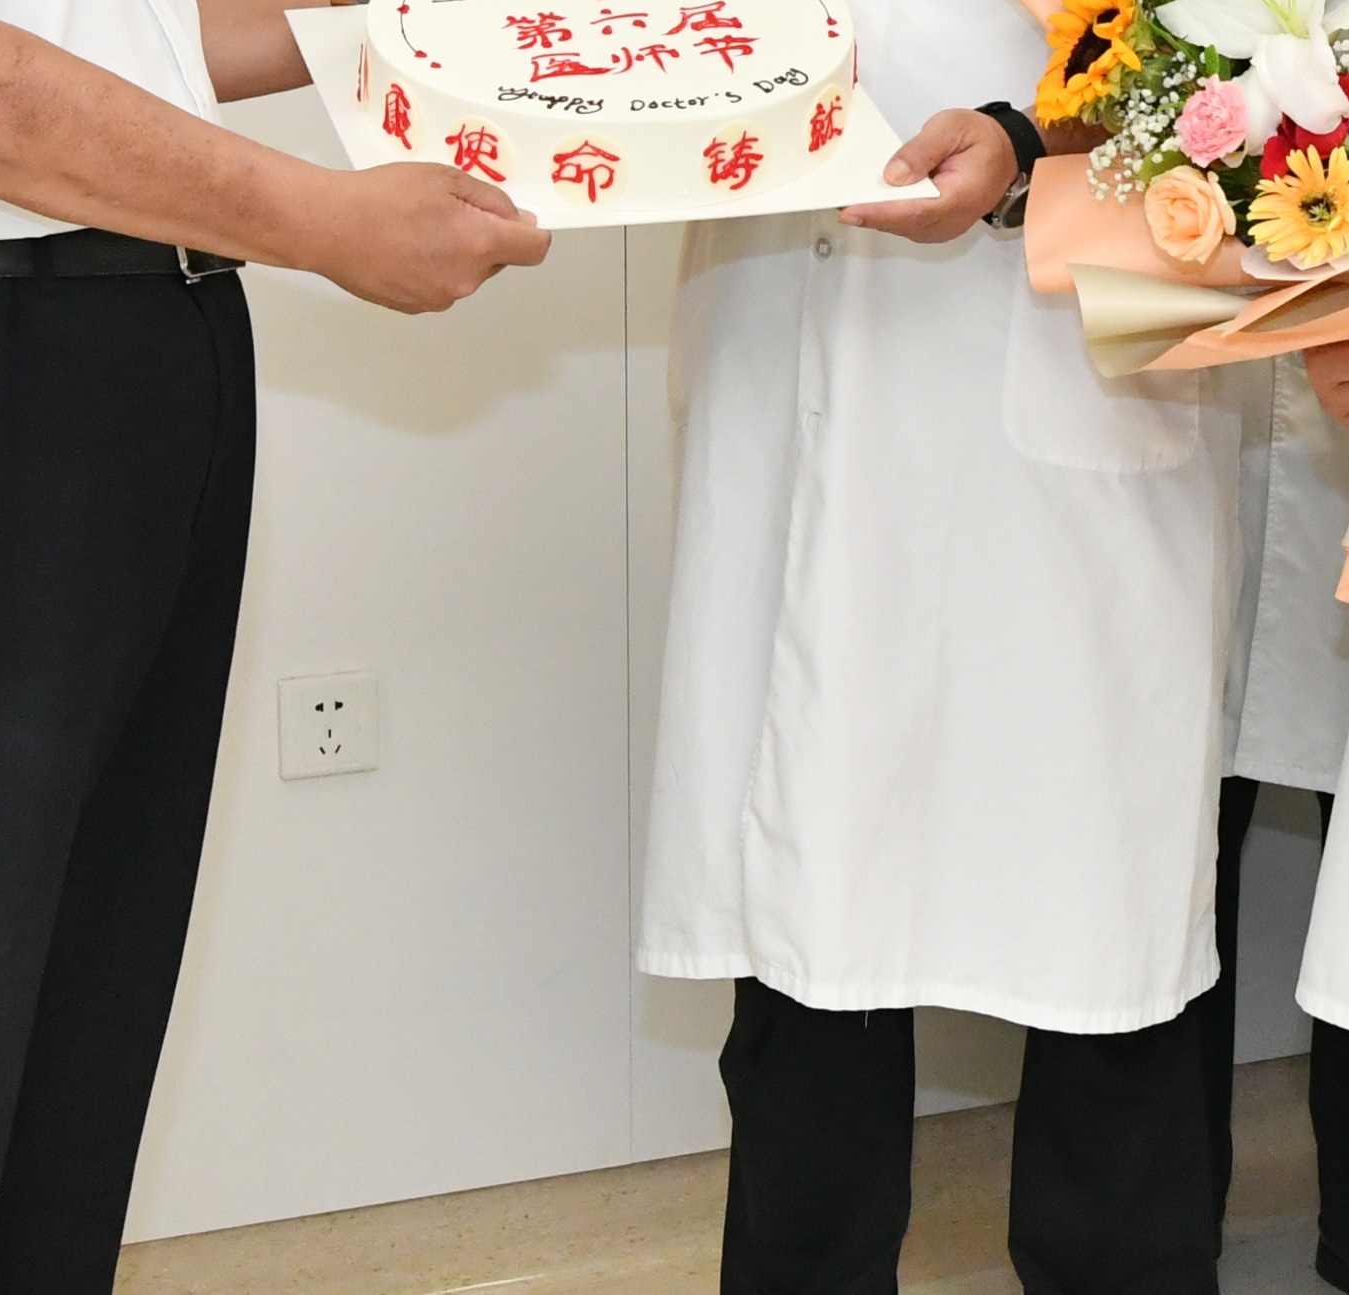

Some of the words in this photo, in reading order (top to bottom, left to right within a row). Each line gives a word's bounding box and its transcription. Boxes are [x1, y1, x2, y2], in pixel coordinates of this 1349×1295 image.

[501, 0, 743, 49] 第六届
[530, 34, 761, 82] 医师节
[753, 67, 809, 94] Day
